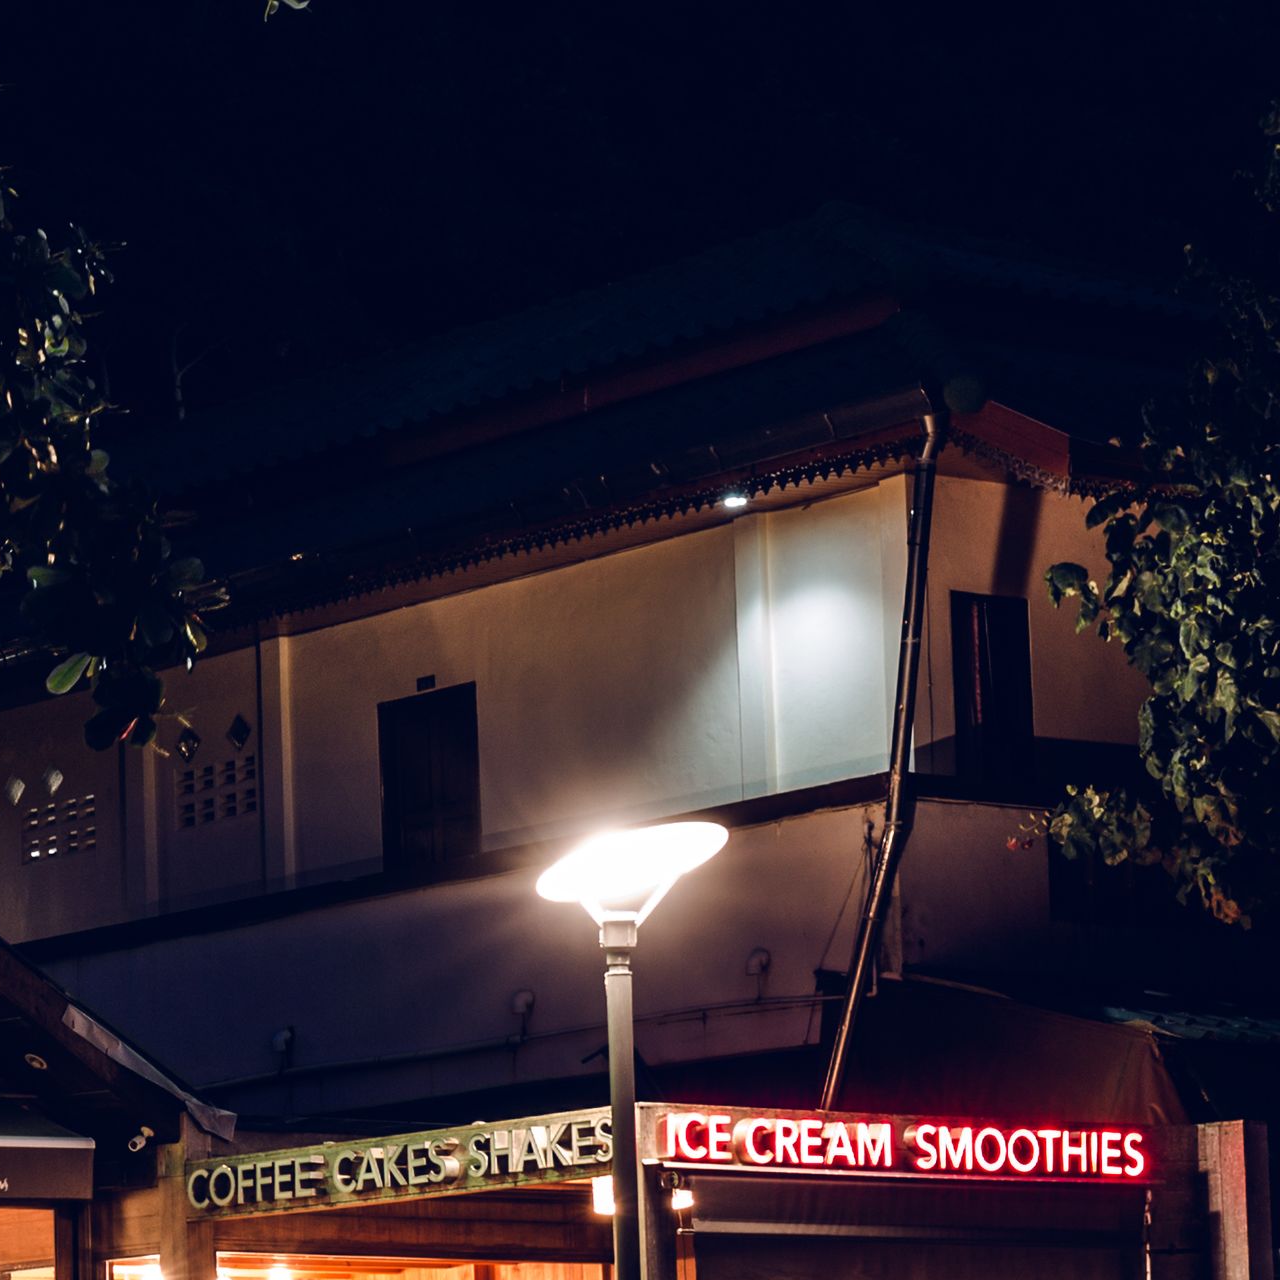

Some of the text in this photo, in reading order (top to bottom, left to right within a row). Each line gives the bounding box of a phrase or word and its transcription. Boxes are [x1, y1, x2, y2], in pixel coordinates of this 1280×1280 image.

[187, 1117, 614, 1210] COFFEE CAKES SHAKES
[666, 1112, 1145, 1177] ICE CREAM SMOOTHIES
